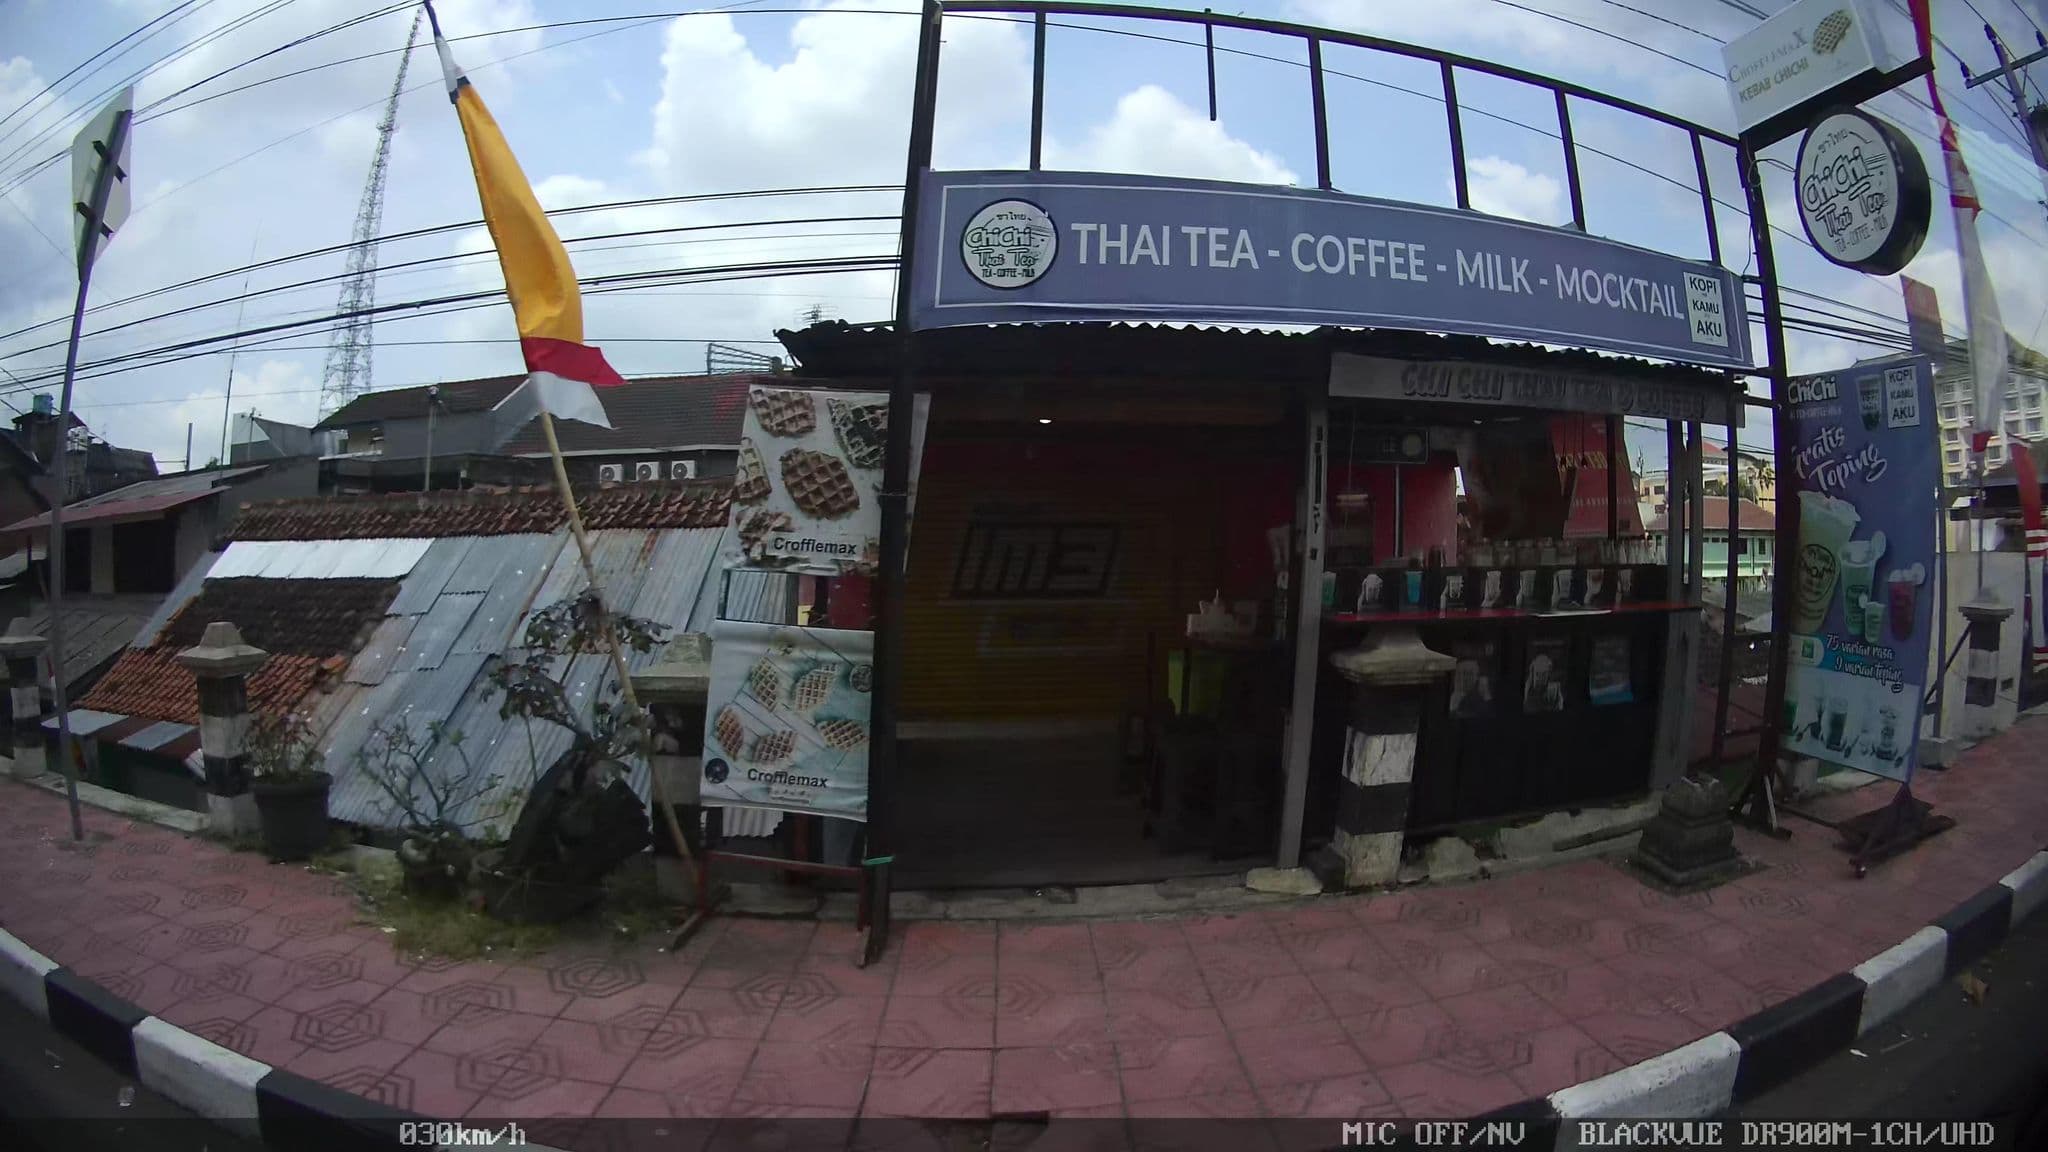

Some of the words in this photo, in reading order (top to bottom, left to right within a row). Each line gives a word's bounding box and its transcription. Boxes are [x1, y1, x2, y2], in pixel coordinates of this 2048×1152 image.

[1739, 77, 1772, 103] KEBAB
[1774, 57, 1809, 85] CHICHI
[1071, 223, 1170, 266] THAI
[1181, 226, 1260, 269] TEA
[1291, 233, 1428, 282] COFFEE
[1456, 249, 1534, 295] MILK
[1555, 264, 1685, 320] MOCKTAIL
[1690, 276, 1716, 295] KOPI
[1693, 299, 1719, 314] KAMU
[1697, 320, 1722, 337] AKU
[1889, 369, 1912, 383] KOPI
[1788, 376, 1838, 404] ChiChi
[1890, 390, 1914, 399] KAMU
[1892, 407, 1915, 420] AKU
[1808, 443, 1888, 491] Toping
[774, 537, 857, 554] Crofflemax
[748, 768, 829, 788] Crofflemax
